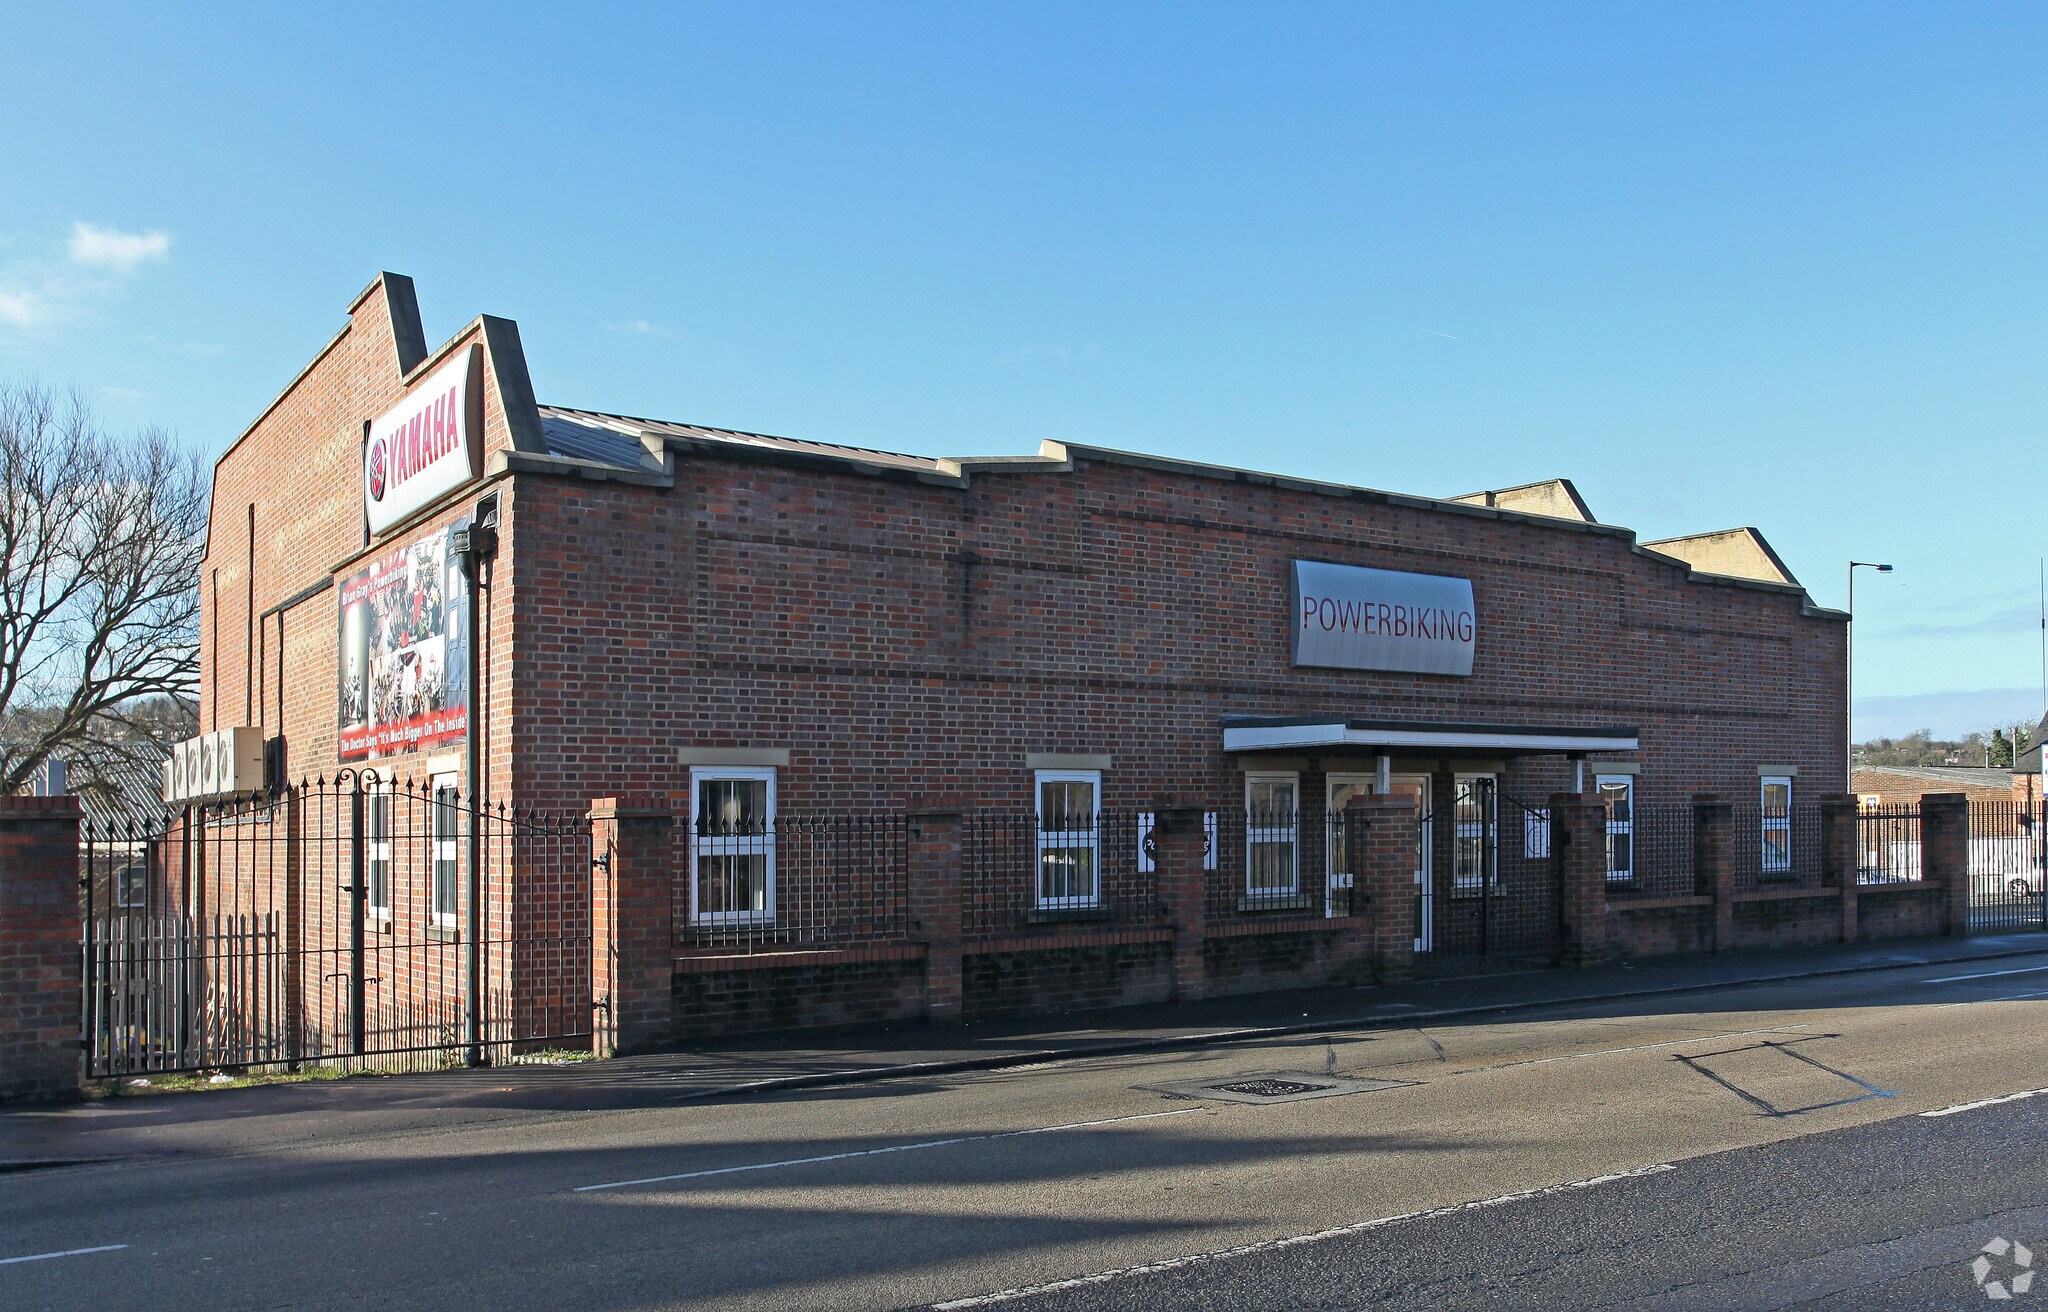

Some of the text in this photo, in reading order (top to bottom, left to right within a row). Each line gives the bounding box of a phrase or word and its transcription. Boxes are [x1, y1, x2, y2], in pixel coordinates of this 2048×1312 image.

[390, 386, 459, 489] YAMAHA
[343, 565, 407, 606] Brian Gray's Powerbiking
[1304, 596, 1472, 642] POWERBIKING
[350, 737, 365, 751] Doctor
[366, 734, 377, 751] Says
[391, 728, 403, 742] Much
[405, 726, 423, 742] Bigger
[425, 722, 433, 736] On
[434, 719, 445, 734] The
